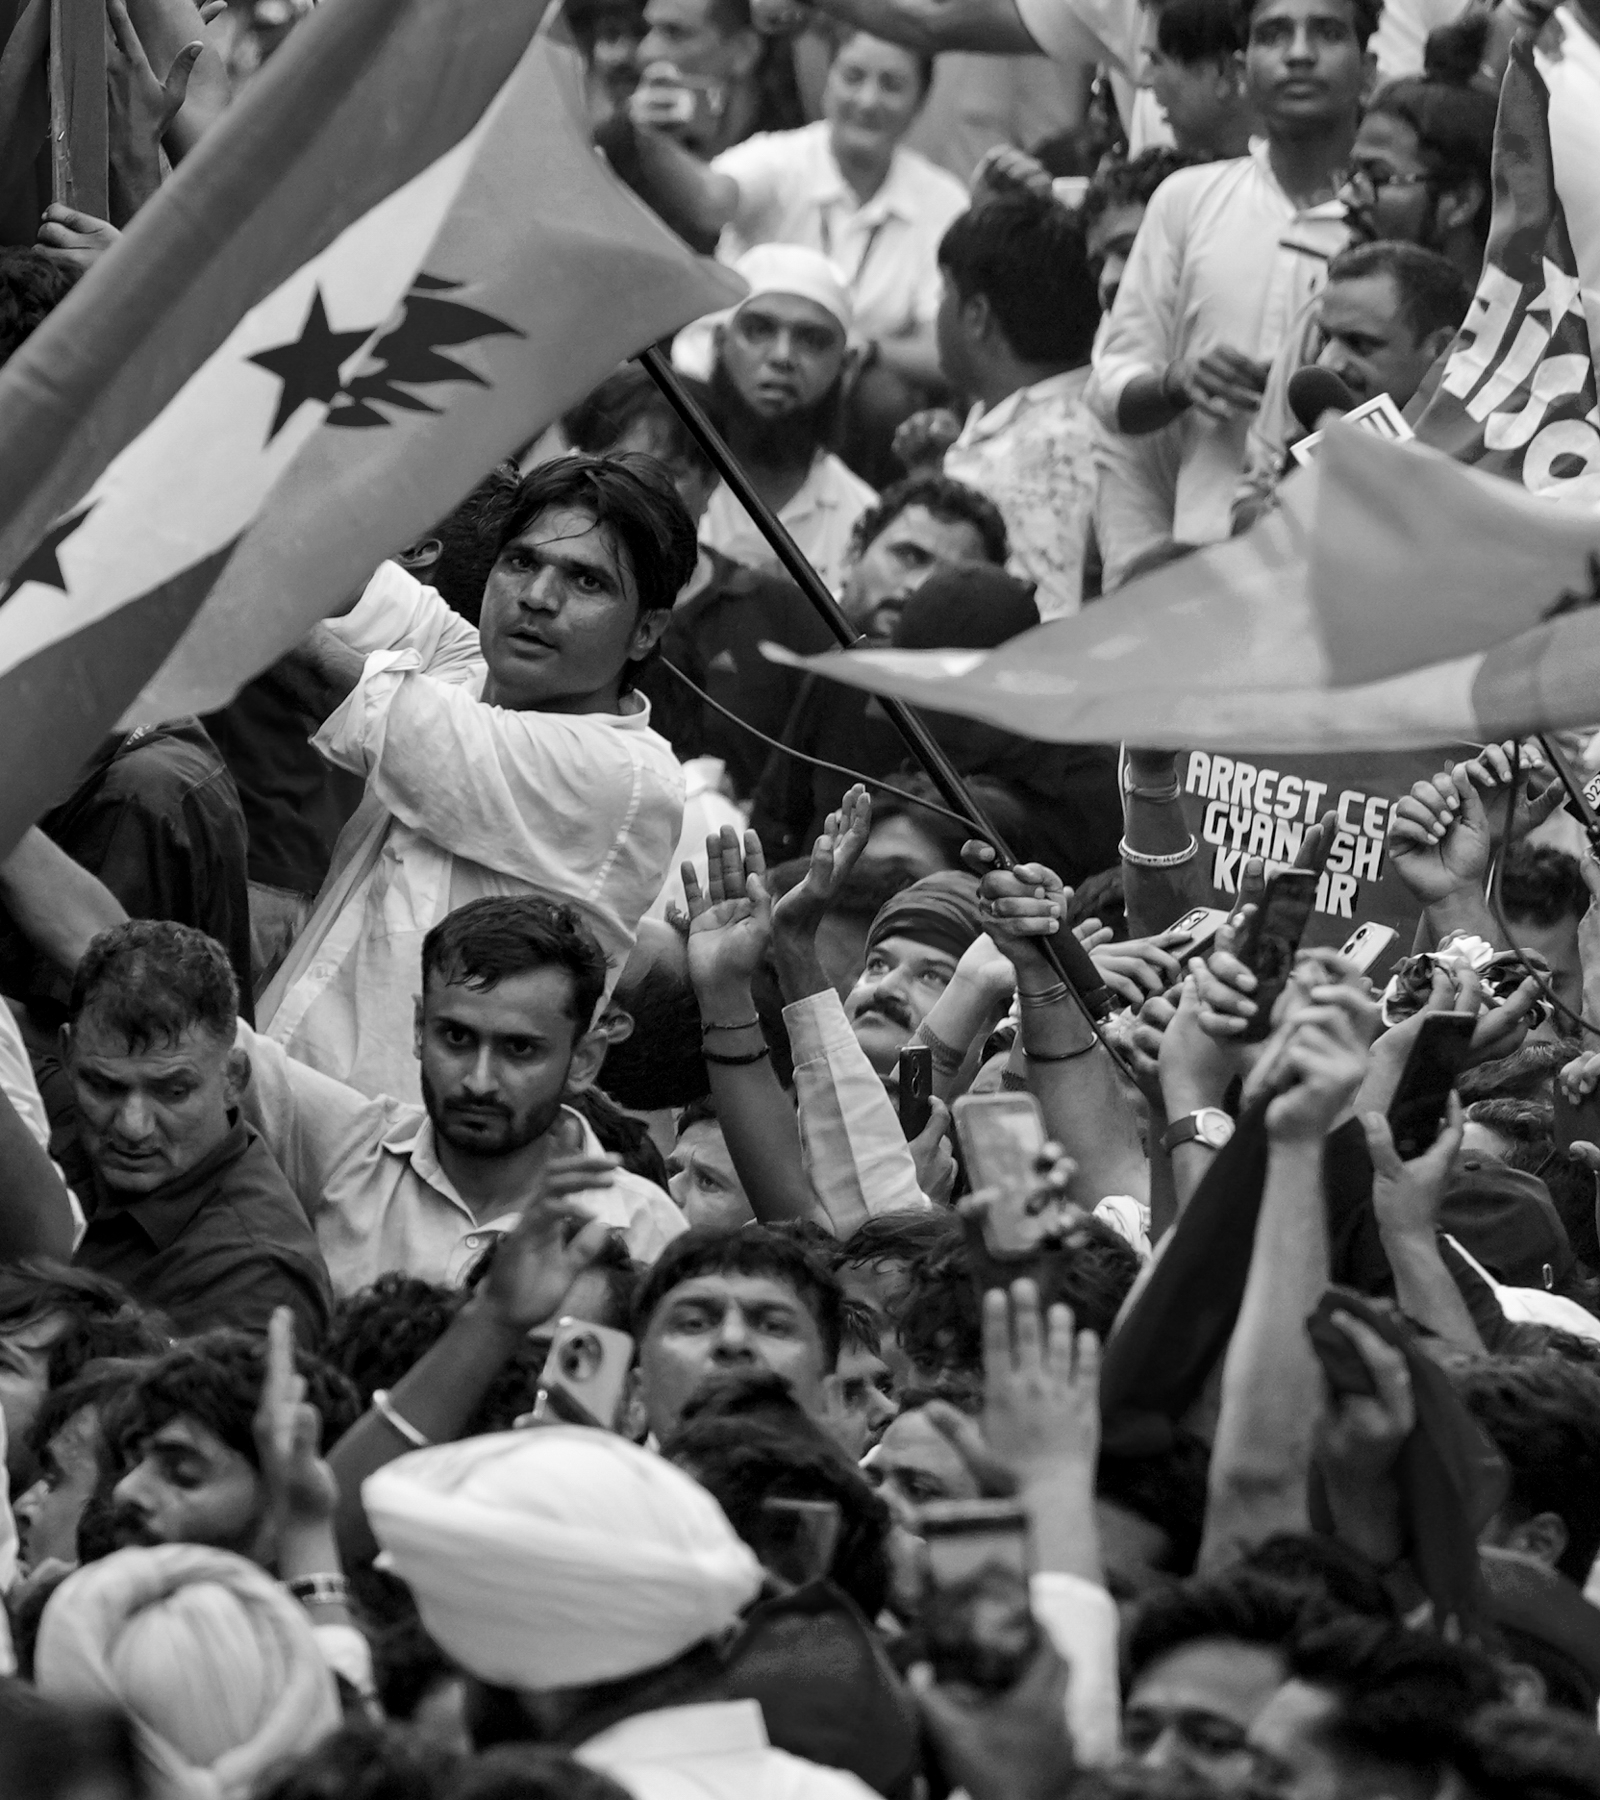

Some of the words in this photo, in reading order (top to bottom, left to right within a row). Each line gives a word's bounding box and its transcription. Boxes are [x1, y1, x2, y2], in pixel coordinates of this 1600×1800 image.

[1185, 750, 1328, 825] ARREST
[1337, 789, 1399, 841] CE
[1202, 800, 1383, 882] GYANSH
